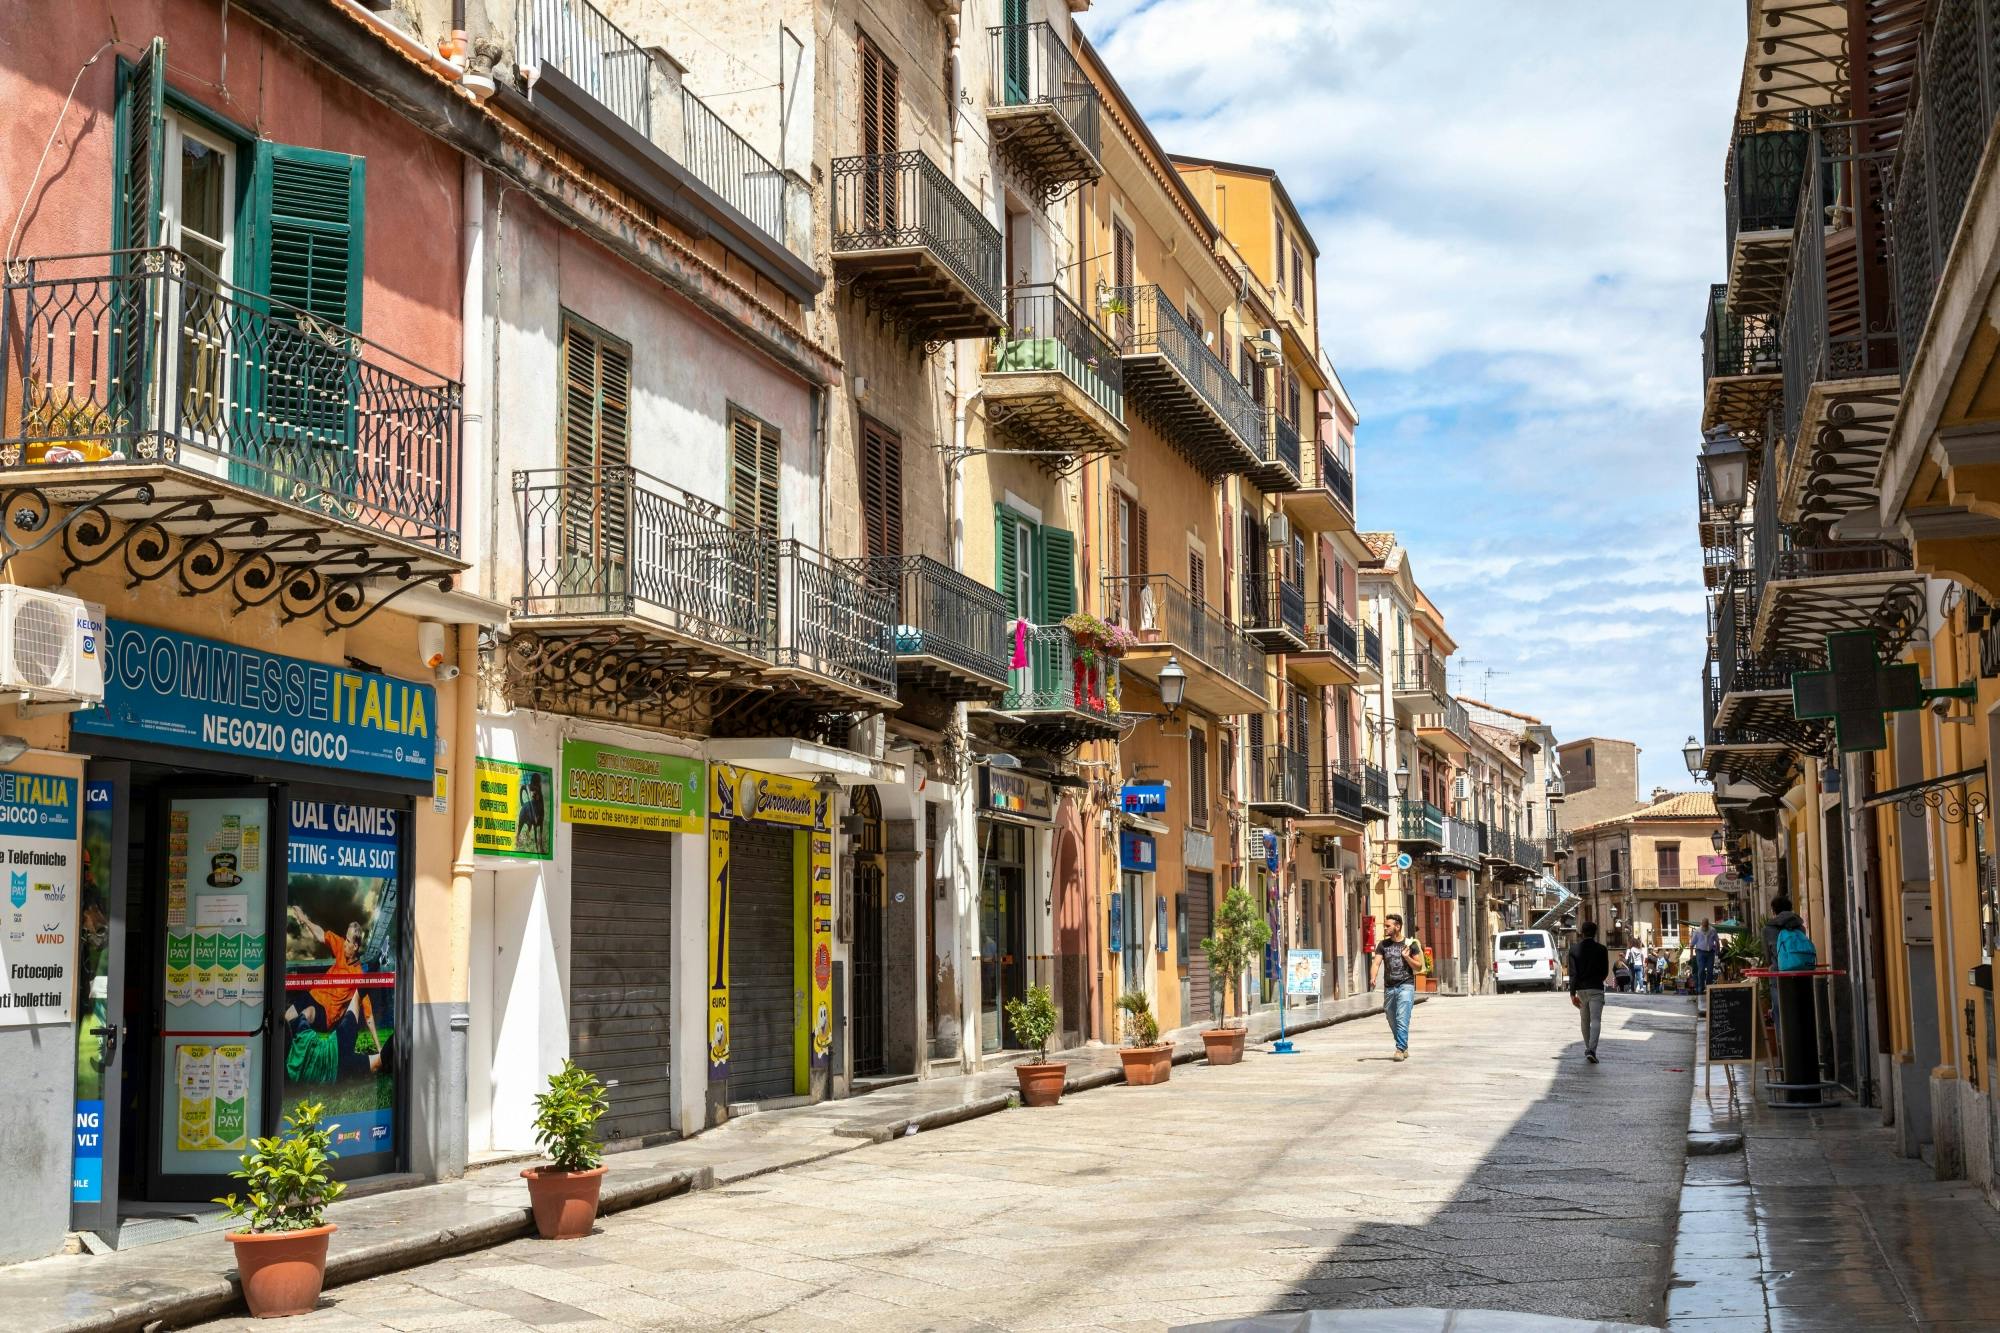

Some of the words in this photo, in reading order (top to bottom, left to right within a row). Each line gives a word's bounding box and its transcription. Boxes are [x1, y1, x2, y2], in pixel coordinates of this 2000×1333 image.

[77, 618, 102, 632] KELON
[203, 713, 286, 753] NEGOZIO
[291, 727, 348, 762] GIOCO
[480, 780, 508, 796] GRANDE
[569, 769, 608, 800] L'OASI
[610, 775, 638, 805] DEGLI
[640, 778, 683, 811] ANIMALI
[480, 798, 508, 814] OFFERTA
[1138, 794, 1160, 804] TIM
[0, 805, 38, 824] GIOCO
[292, 800, 328, 830] UAL
[334, 804, 396, 837] GAMES
[569, 806, 587, 820] Tutto
[602, 812, 612, 821] che
[614, 814, 629, 824] serve
[630, 815, 639, 826] per
[644, 816, 660, 826] vostri
[661, 816, 682, 828] animali
[485, 818, 516, 832] MANGIME
[712, 830, 728, 842] TUTTO
[8, 849, 66, 866] Telefoniche
[338, 846, 366, 868] SALA
[370, 849, 396, 870] SLOT
[36, 934, 64, 944] WIND
[12, 964, 63, 980] Fotocopie
[14, 992, 62, 1008] bollettini
[77, 1113, 98, 1128] NG
[218, 1116, 242, 1128] PAY
[78, 1134, 98, 1146] VLT
